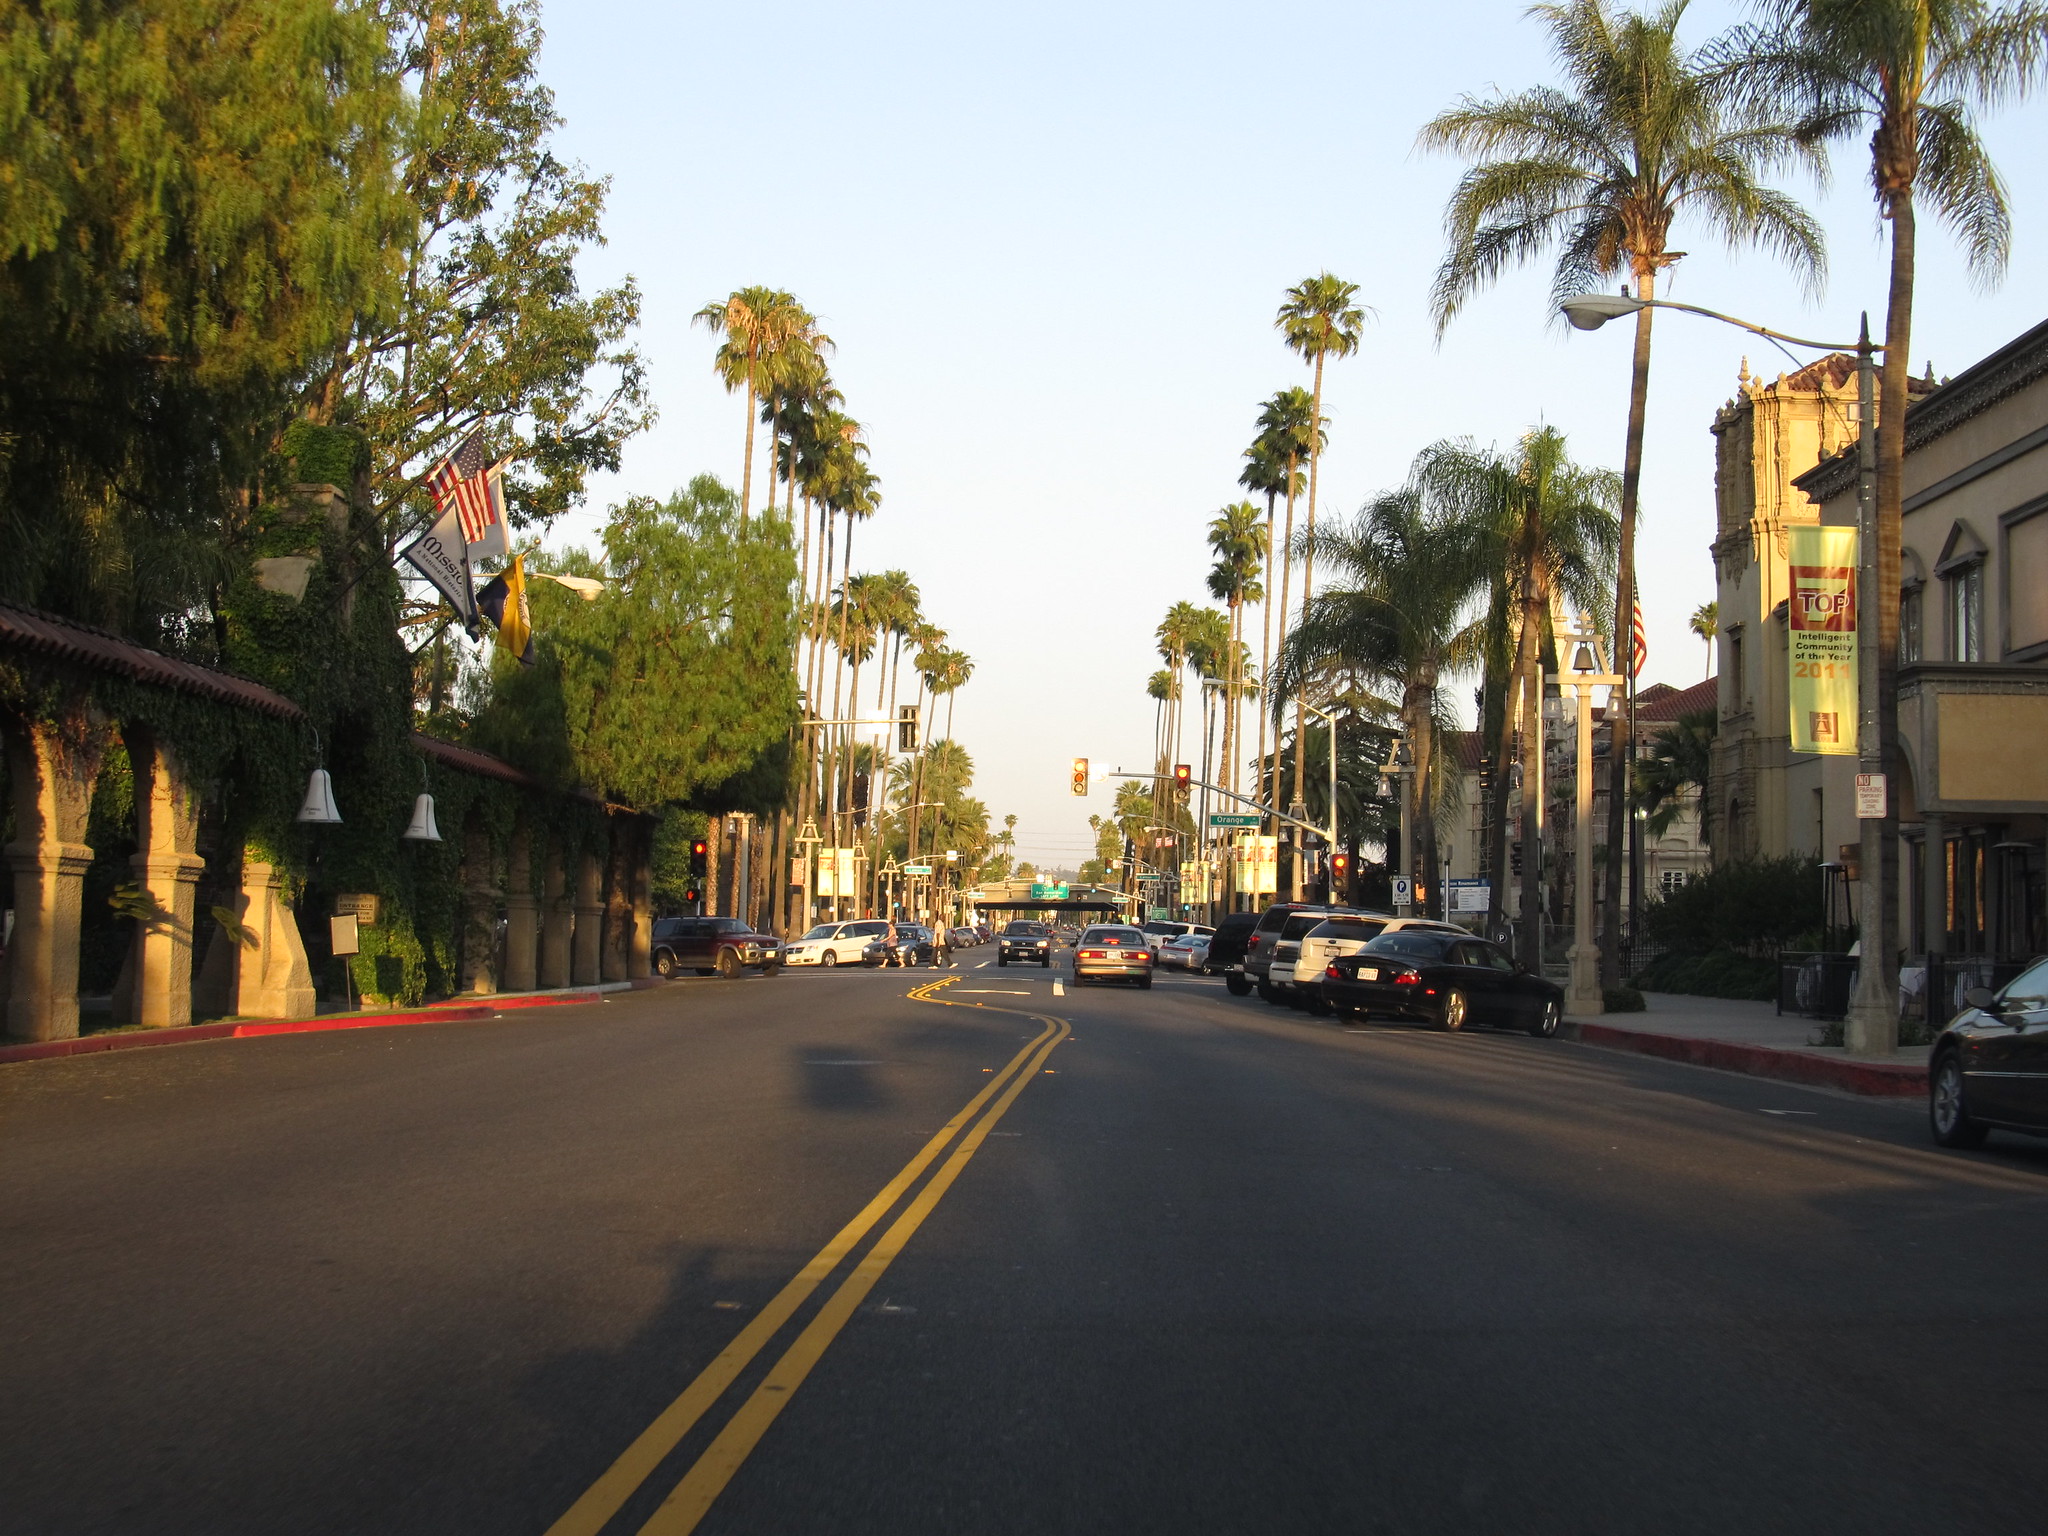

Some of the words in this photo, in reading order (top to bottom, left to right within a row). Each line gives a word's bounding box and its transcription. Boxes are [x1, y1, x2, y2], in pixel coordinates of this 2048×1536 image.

[422, 553, 443, 575] National
[1797, 592, 1850, 615] TOP
[1798, 632, 1851, 642] Intelligent
[1796, 642, 1853, 652] Community
[1795, 652, 1805, 660] of
[1828, 653, 1851, 661] Year
[1795, 662, 1851, 679] 2011
[1857, 774, 1870, 786] NO
[1217, 815, 1245, 825] Orange
